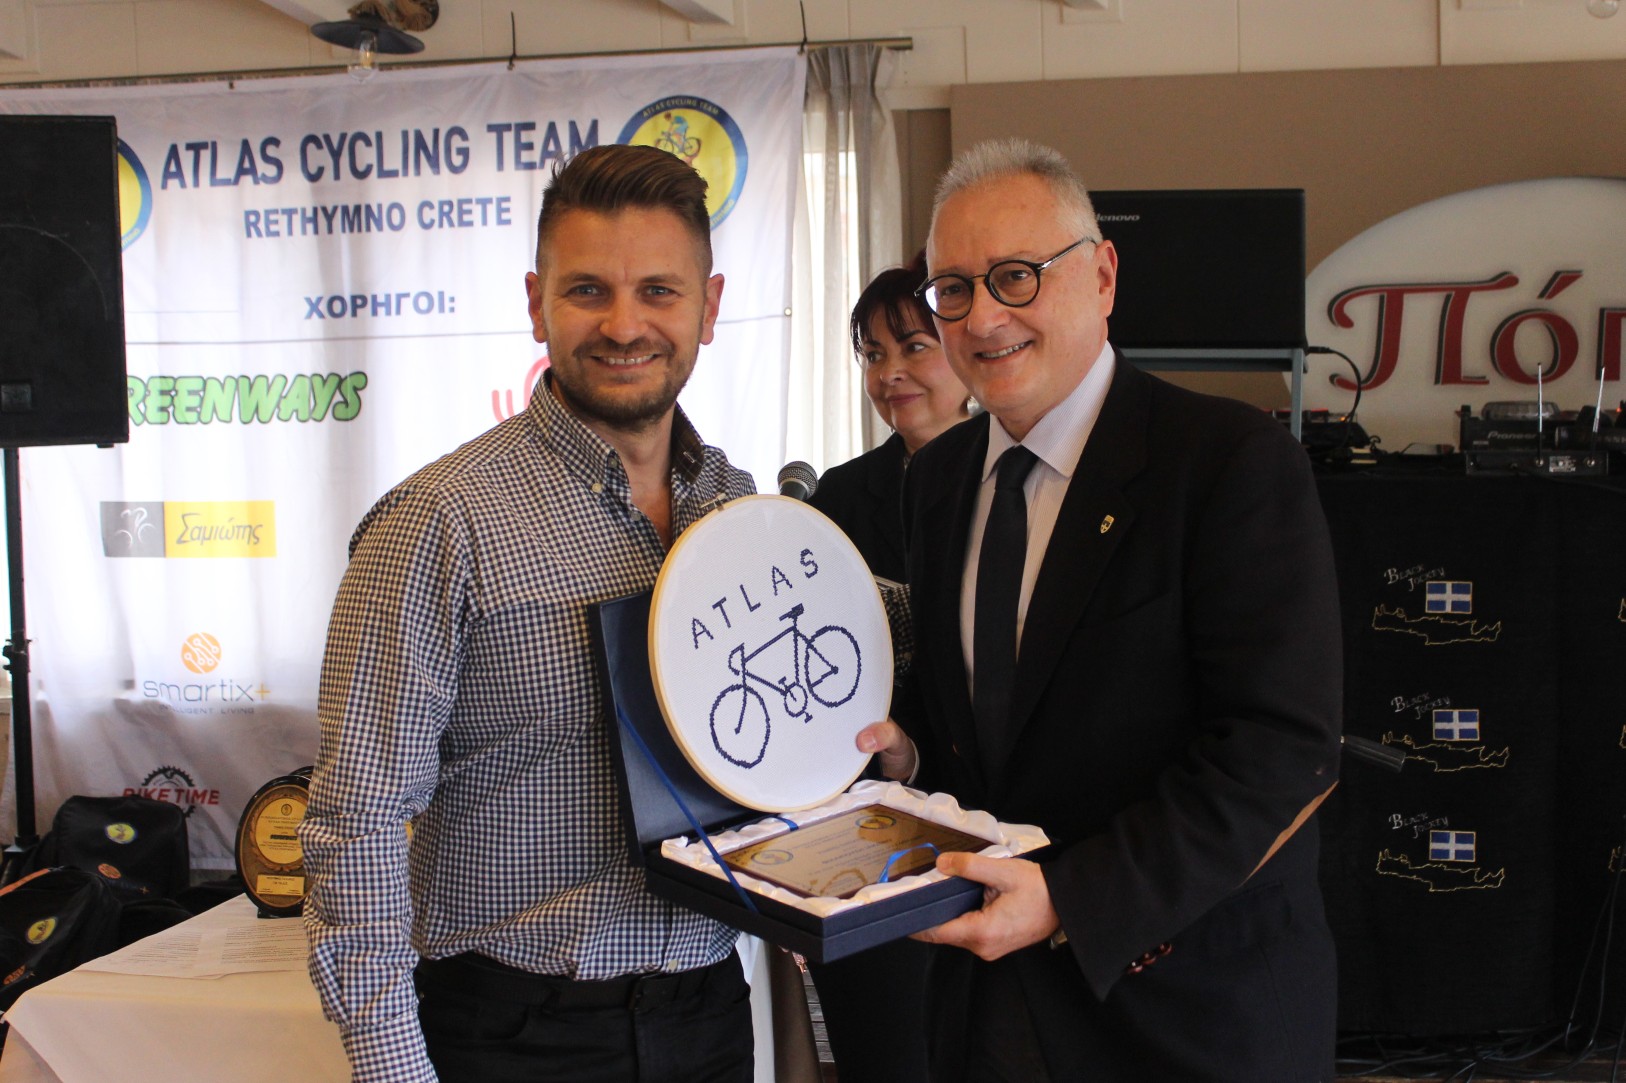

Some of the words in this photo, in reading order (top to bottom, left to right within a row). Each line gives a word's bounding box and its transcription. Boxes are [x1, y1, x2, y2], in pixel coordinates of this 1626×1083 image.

[160, 136, 284, 190] ATLAS
[299, 125, 470, 183] CYCLING
[486, 118, 599, 172] TEAM
[244, 202, 406, 239] RETHYMNO
[417, 196, 512, 231] CRETE
[1096, 212, 1141, 222] lenovo
[127, 371, 368, 427] REENWAYS
[175, 512, 264, 546] Σαμιώτης
[690, 549, 819, 649] ATLAS
[220, 707, 255, 715] LIVING
[174, 788, 221, 806] TIME
